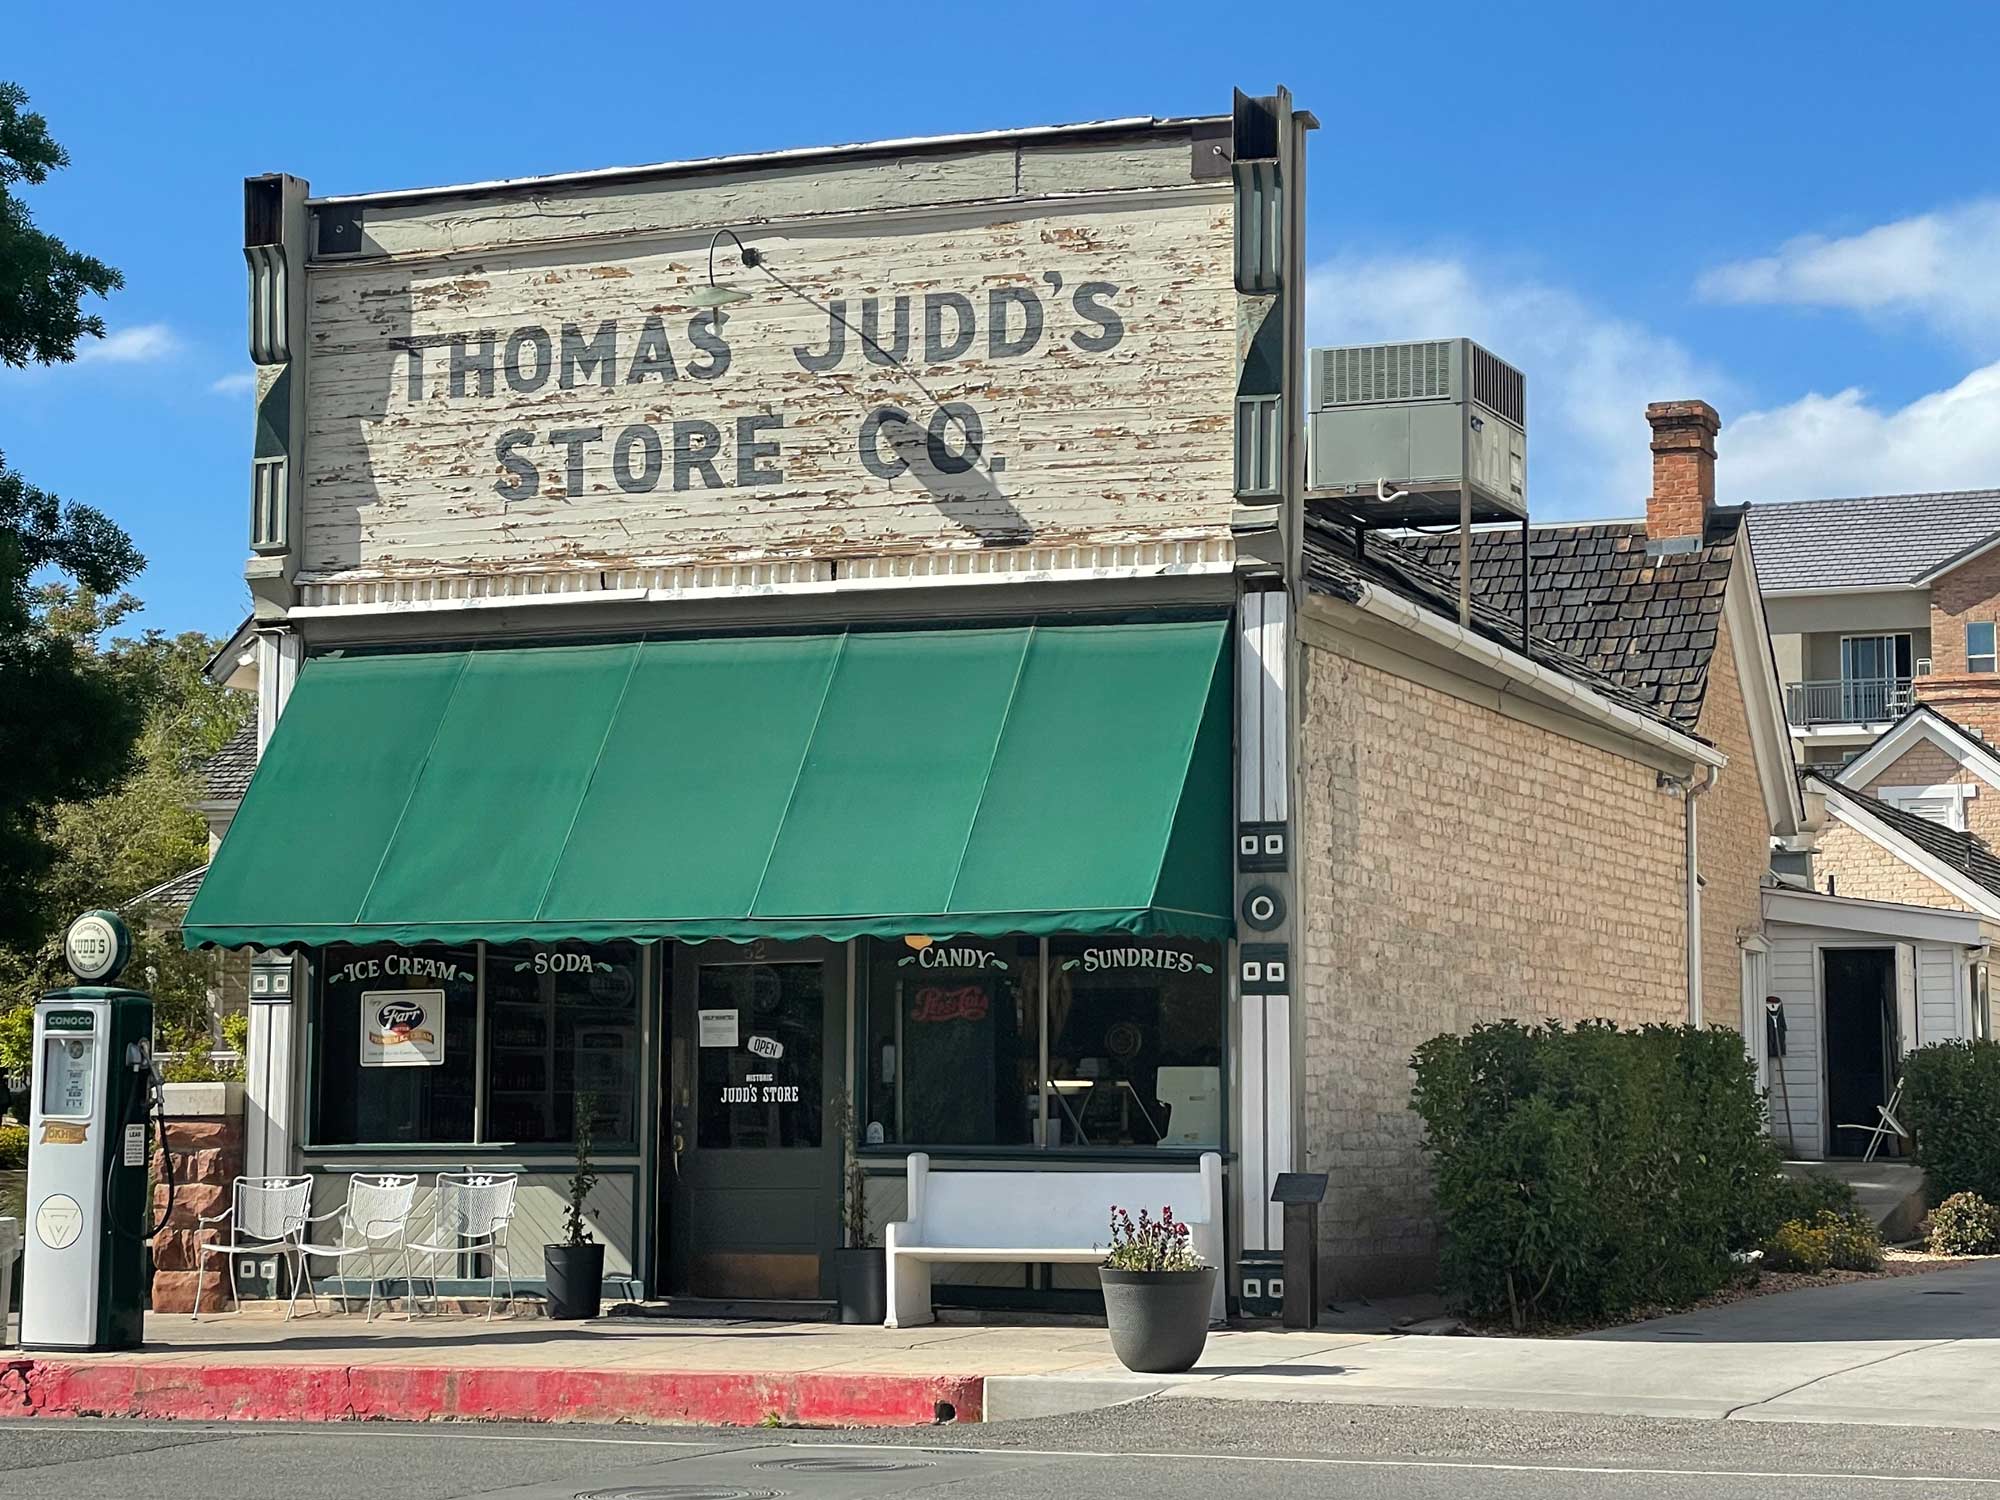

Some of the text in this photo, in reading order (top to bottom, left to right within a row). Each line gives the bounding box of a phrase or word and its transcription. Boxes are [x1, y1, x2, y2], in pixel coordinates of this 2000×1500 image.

[390, 271, 1125, 401] THOMAS JUDD'S
[495, 402, 1006, 501] STORE CO.
[72, 939, 105, 954] JUDD'S
[534, 953, 594, 974] SODA
[919, 947, 996, 968] CANDY
[1083, 948, 1194, 973] SUNDRIES
[344, 955, 457, 982] ICE CREAM
[48, 1016, 93, 1026] CONOCO
[383, 1004, 421, 1030] Farr
[753, 1039, 778, 1056] OPEN
[721, 1084, 799, 1103] JUDD'S STORE
